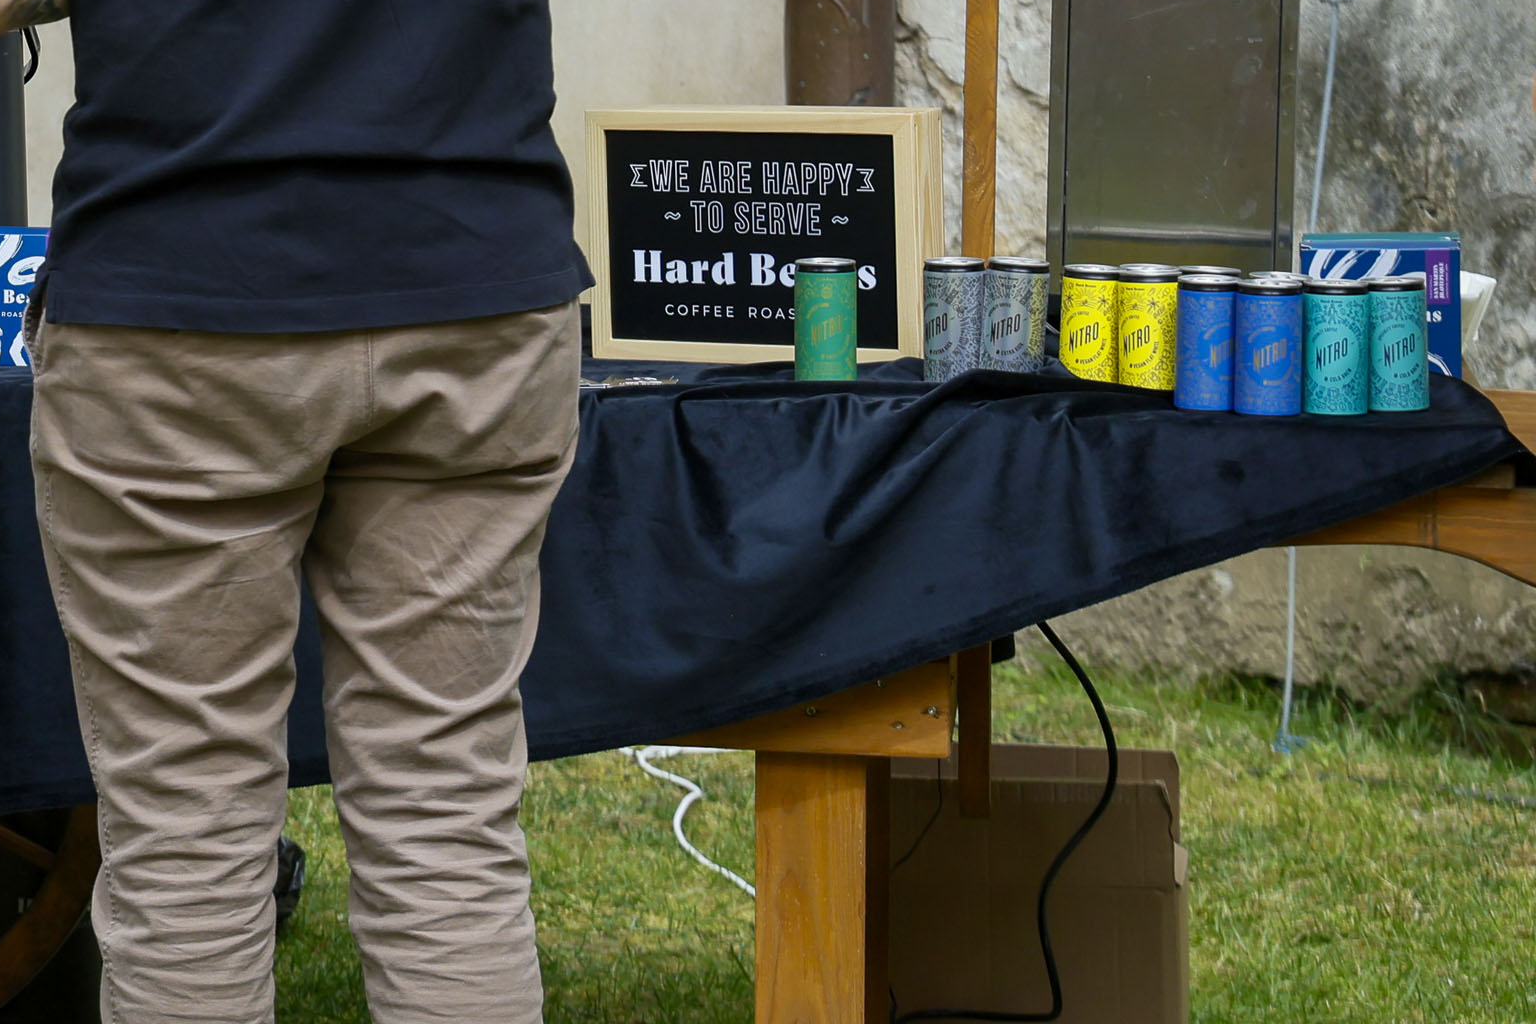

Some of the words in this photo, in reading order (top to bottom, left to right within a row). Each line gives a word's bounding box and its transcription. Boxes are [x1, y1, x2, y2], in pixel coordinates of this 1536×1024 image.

[649, 160, 690, 192] WE
[700, 160, 752, 194] ARE
[762, 162, 853, 196] HAPPY
[690, 200, 724, 233] TO
[734, 201, 821, 236] SERVE
[632, 249, 736, 286] Hard
[750, 252, 878, 290] Bes
[664, 304, 735, 318] COFFEE
[748, 306, 795, 320] ROAS
[990, 313, 1020, 345] NITRO
[1069, 322, 1099, 354] NITRO
[1124, 325, 1150, 359] NITRO
[1253, 338, 1286, 373] NITRO
[1316, 337, 1348, 372] NITRO
[1384, 333, 1416, 368] NITRO
